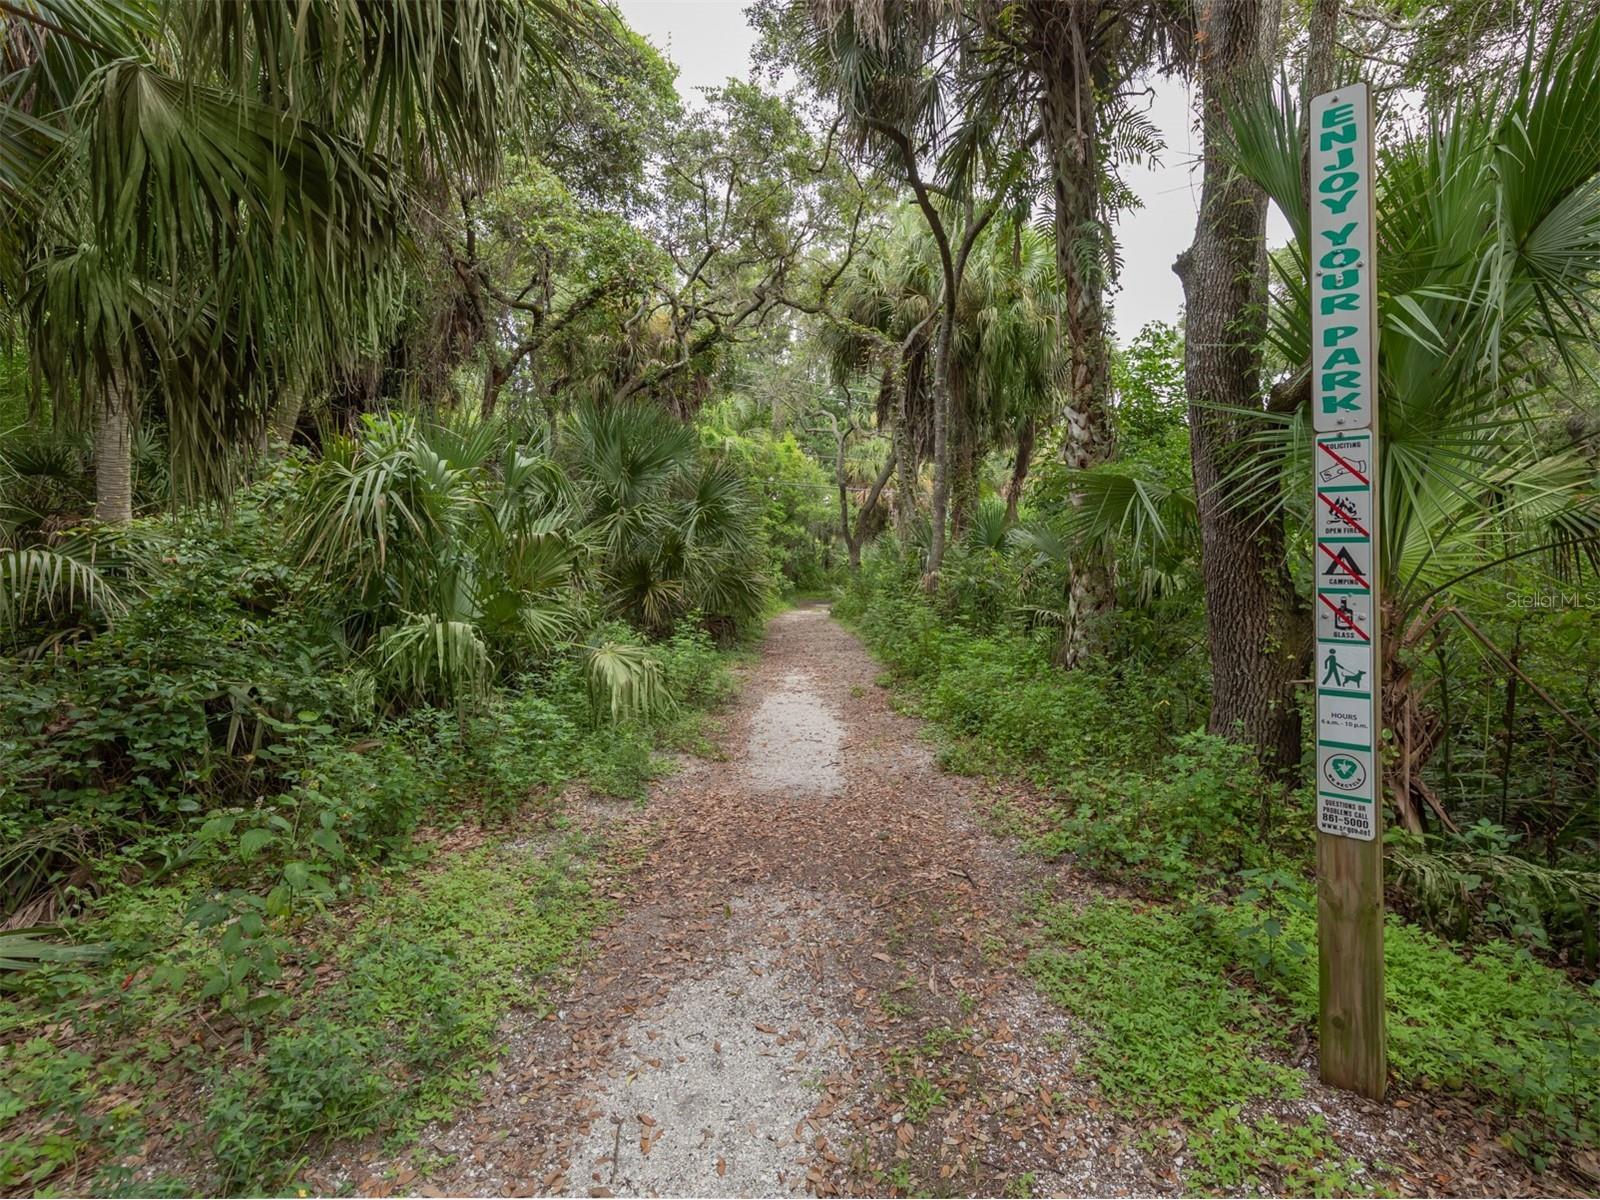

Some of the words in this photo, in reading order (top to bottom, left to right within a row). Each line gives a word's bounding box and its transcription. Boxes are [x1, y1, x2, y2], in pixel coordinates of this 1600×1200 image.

[1318, 103, 1360, 215] ENJOY
[1319, 222, 1361, 316] YOUR
[1321, 325, 1362, 414] PARK
[1325, 527, 1342, 535] OPEN
[1333, 631, 1355, 639] GLASS
[1331, 712, 1358, 721] HOURS
[1325, 799, 1356, 810] QUESTIONS
[1323, 806, 1352, 817] PROBLEMS
[1353, 811, 1369, 820] CALL
[1322, 813, 1369, 829] 861-5000
